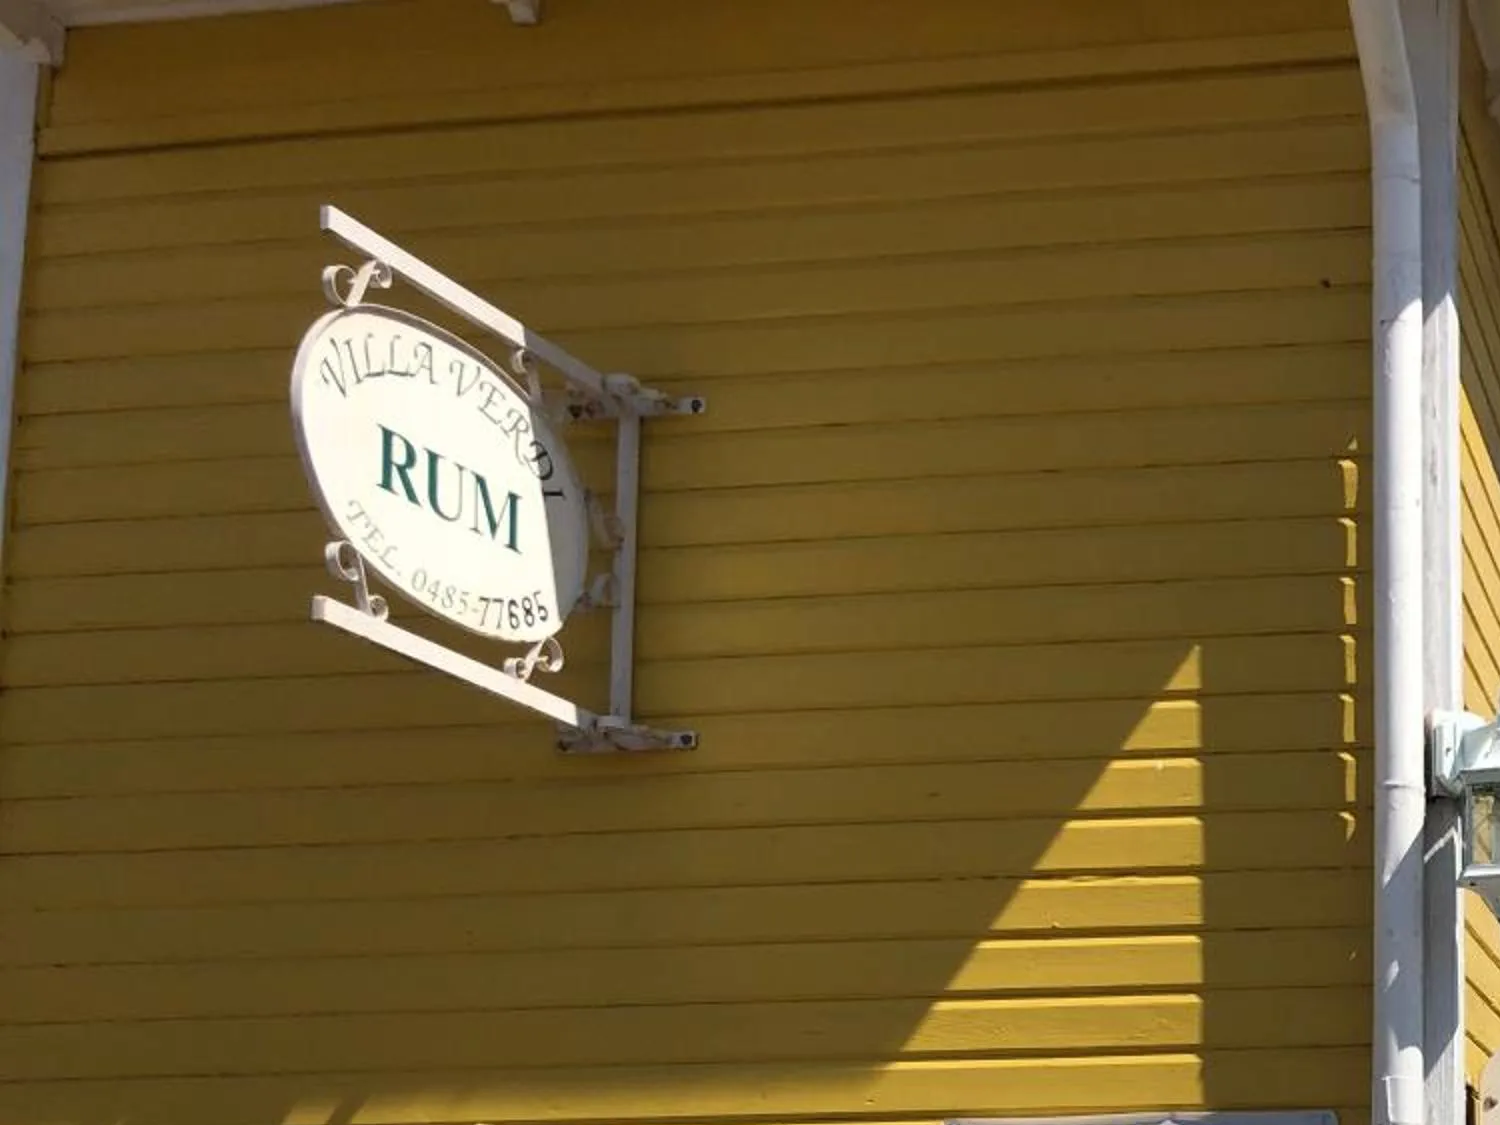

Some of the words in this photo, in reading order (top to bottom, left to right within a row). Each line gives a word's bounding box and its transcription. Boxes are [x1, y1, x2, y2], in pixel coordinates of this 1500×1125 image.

[319, 333, 438, 399] VILLA
[449, 358, 565, 501] VERDI
[375, 422, 523, 556] RUM
[411, 568, 549, 631] 0485-77685
